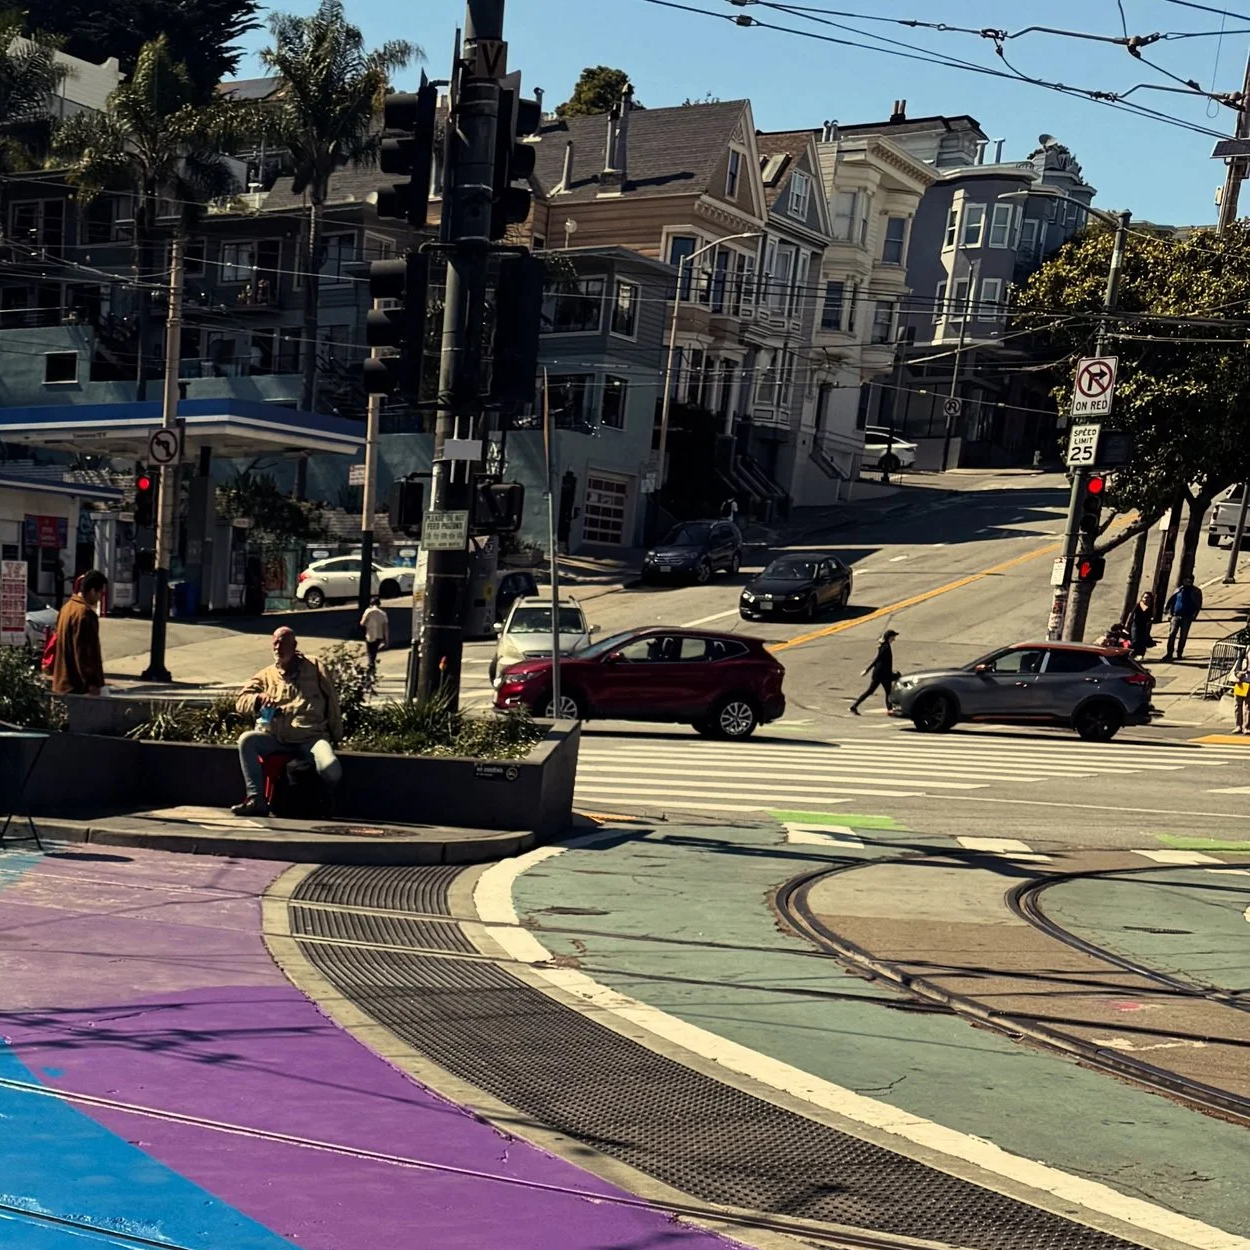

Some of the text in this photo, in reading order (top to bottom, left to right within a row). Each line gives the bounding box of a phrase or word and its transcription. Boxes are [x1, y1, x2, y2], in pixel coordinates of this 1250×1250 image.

[1075, 400, 1108, 412] ON RED
[1073, 428, 1097, 437] SPEED
[1074, 437, 1094, 445] LIMIT
[1070, 446, 1093, 461] 25
